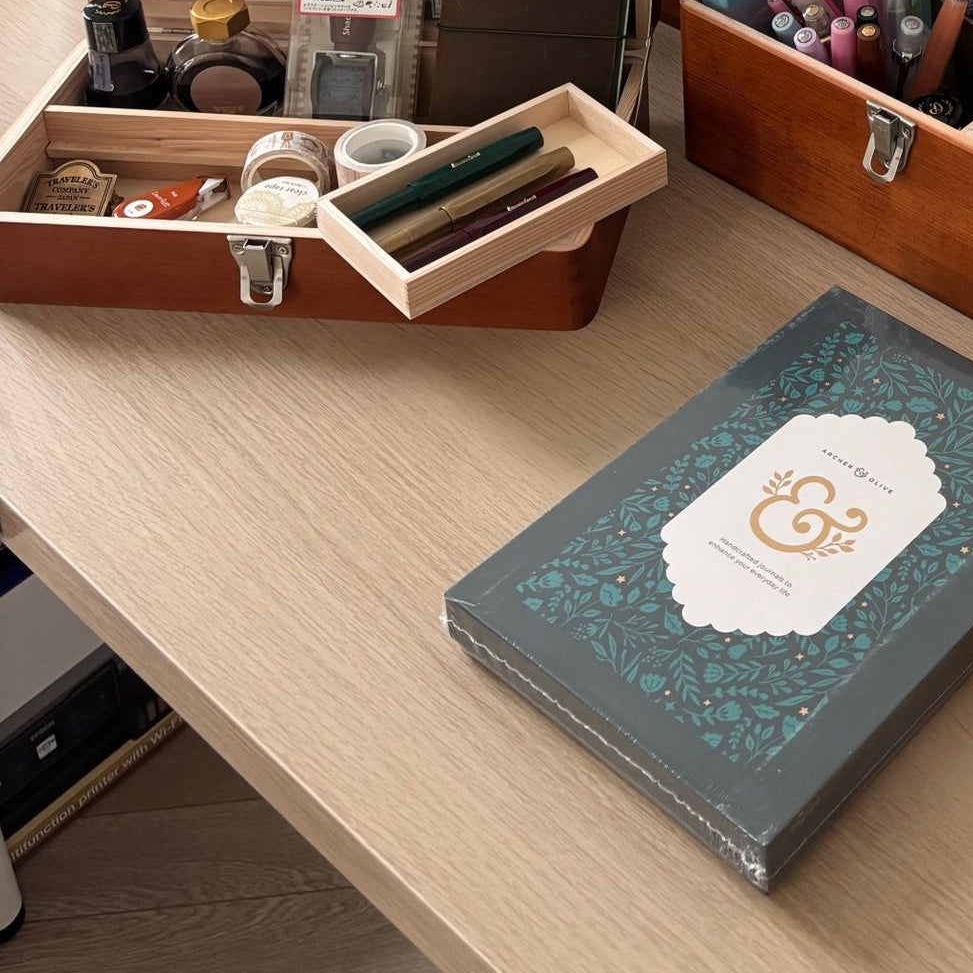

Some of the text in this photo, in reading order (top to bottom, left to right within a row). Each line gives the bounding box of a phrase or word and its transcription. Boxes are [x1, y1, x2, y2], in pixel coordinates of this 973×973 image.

[45, 176, 100, 188] TRAVELER'S
[264, 182, 286, 192] tape
[287, 187, 309, 196] clear
[34, 203, 96, 212] TRAVELER'S
[821, 449, 853, 470] ARCHER
[868, 477, 894, 494] OLIVE
[708, 540, 790, 597] enhance your everyday life
[720, 537, 793, 588] Handcrafted journals to
[79, 767, 120, 808] printer
[122, 743, 148, 768] with
